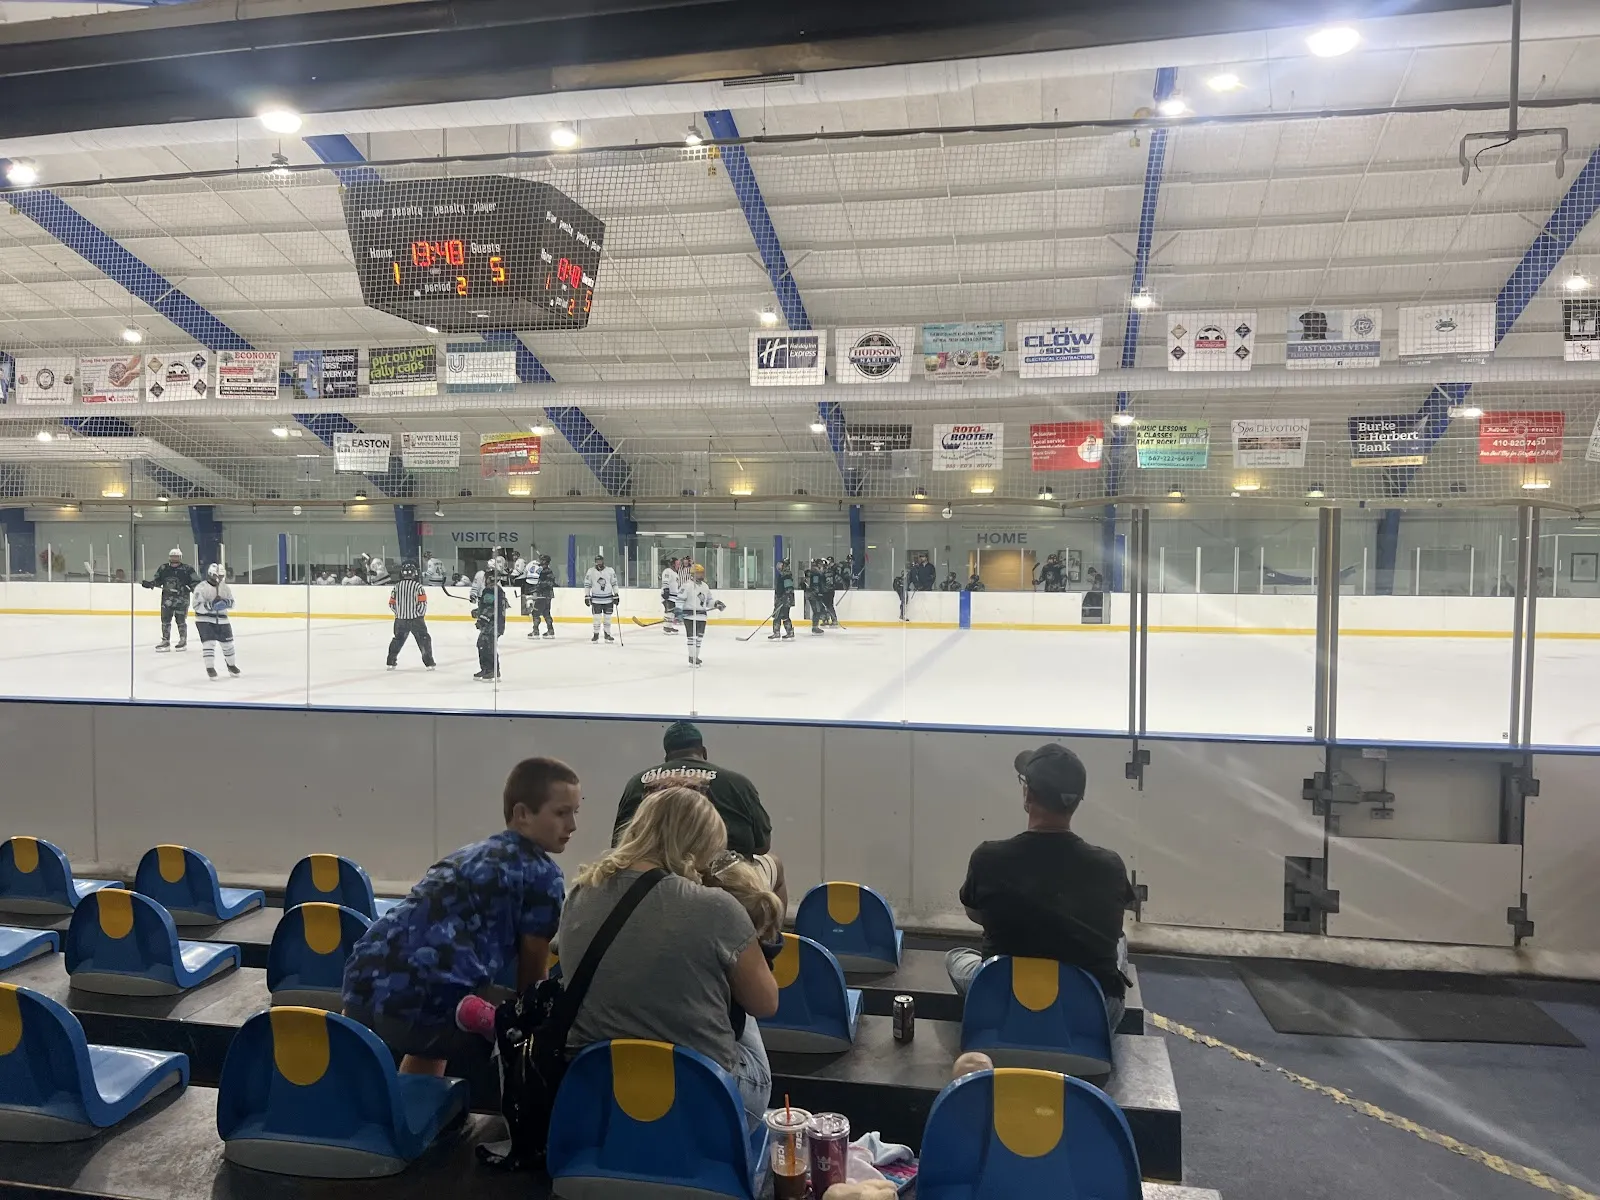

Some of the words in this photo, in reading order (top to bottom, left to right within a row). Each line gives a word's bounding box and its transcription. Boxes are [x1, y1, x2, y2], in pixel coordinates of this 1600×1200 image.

[360, 208, 383, 220] player
[392, 205, 422, 218] penalty
[434, 203, 466, 216] penalty
[473, 201, 497, 214] player
[370, 248, 393, 258] Home
[470, 242, 500, 254] Guests
[490, 256, 505, 282] 5
[424, 281, 451, 294] period
[456, 277, 467, 295] 2
[1024, 333, 1094, 347] CLOW
[790, 350, 817, 358] Express
[1320, 344, 1346, 352] COAST
[1348, 343, 1369, 351] VETS
[234, 351, 277, 359] ECONOMY
[372, 353, 390, 369] put
[392, 352, 407, 362] on
[408, 346, 435, 361] your
[370, 365, 395, 379] rally
[397, 360, 424, 373] caps
[1233, 422, 1254, 435] Spa
[1257, 424, 1308, 432] DEVOTION
[1358, 421, 1396, 431] Burke
[1369, 431, 1419, 441] Herbert
[352, 439, 390, 448] EASTON
[1358, 442, 1392, 452] Bank
[451, 532, 518, 542] VISITORS
[977, 532, 1027, 544] HOME
[641, 765, 717, 784] Glorious
[777, 1144, 786, 1165] ICED
